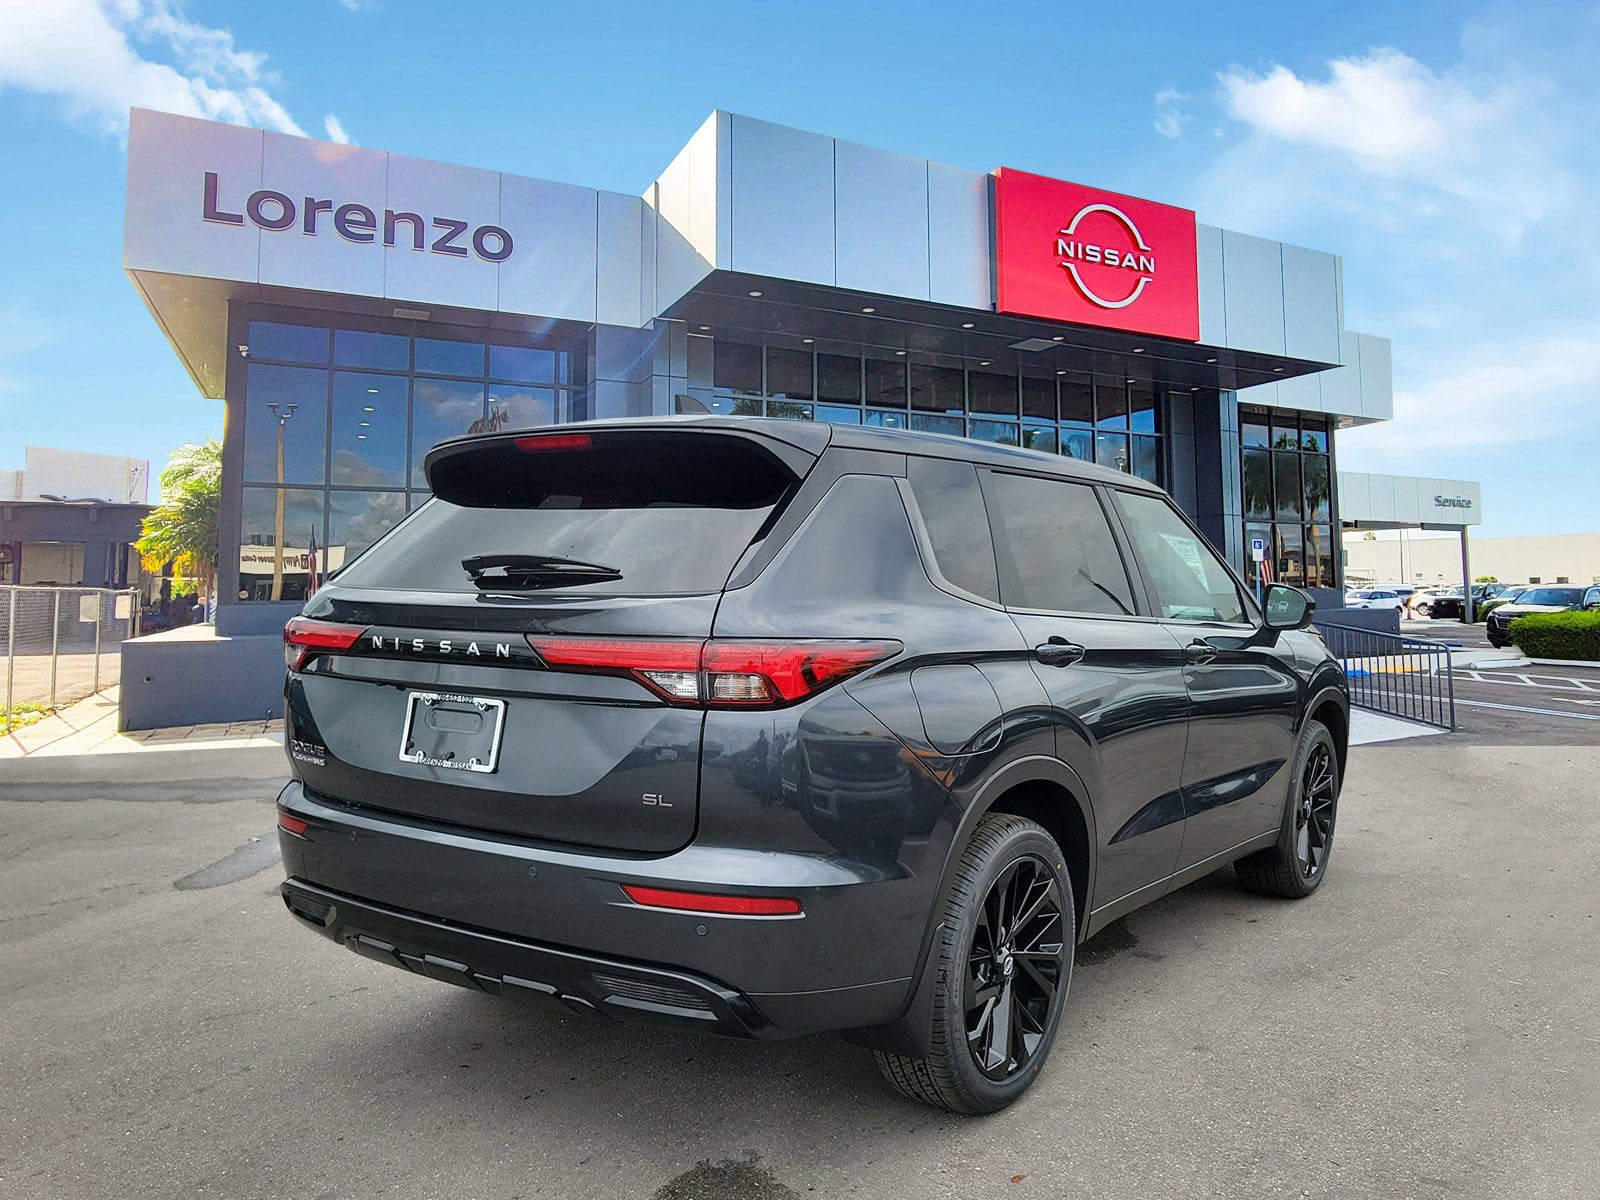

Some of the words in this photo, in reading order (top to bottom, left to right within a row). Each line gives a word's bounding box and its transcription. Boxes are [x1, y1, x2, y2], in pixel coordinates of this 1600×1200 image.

[203, 171, 514, 262] Lorenzo
[1057, 238, 1155, 273] NISSAN
[1434, 495, 1472, 509] Service
[372, 635, 510, 658] NISSAN
[642, 793, 673, 807] SL
